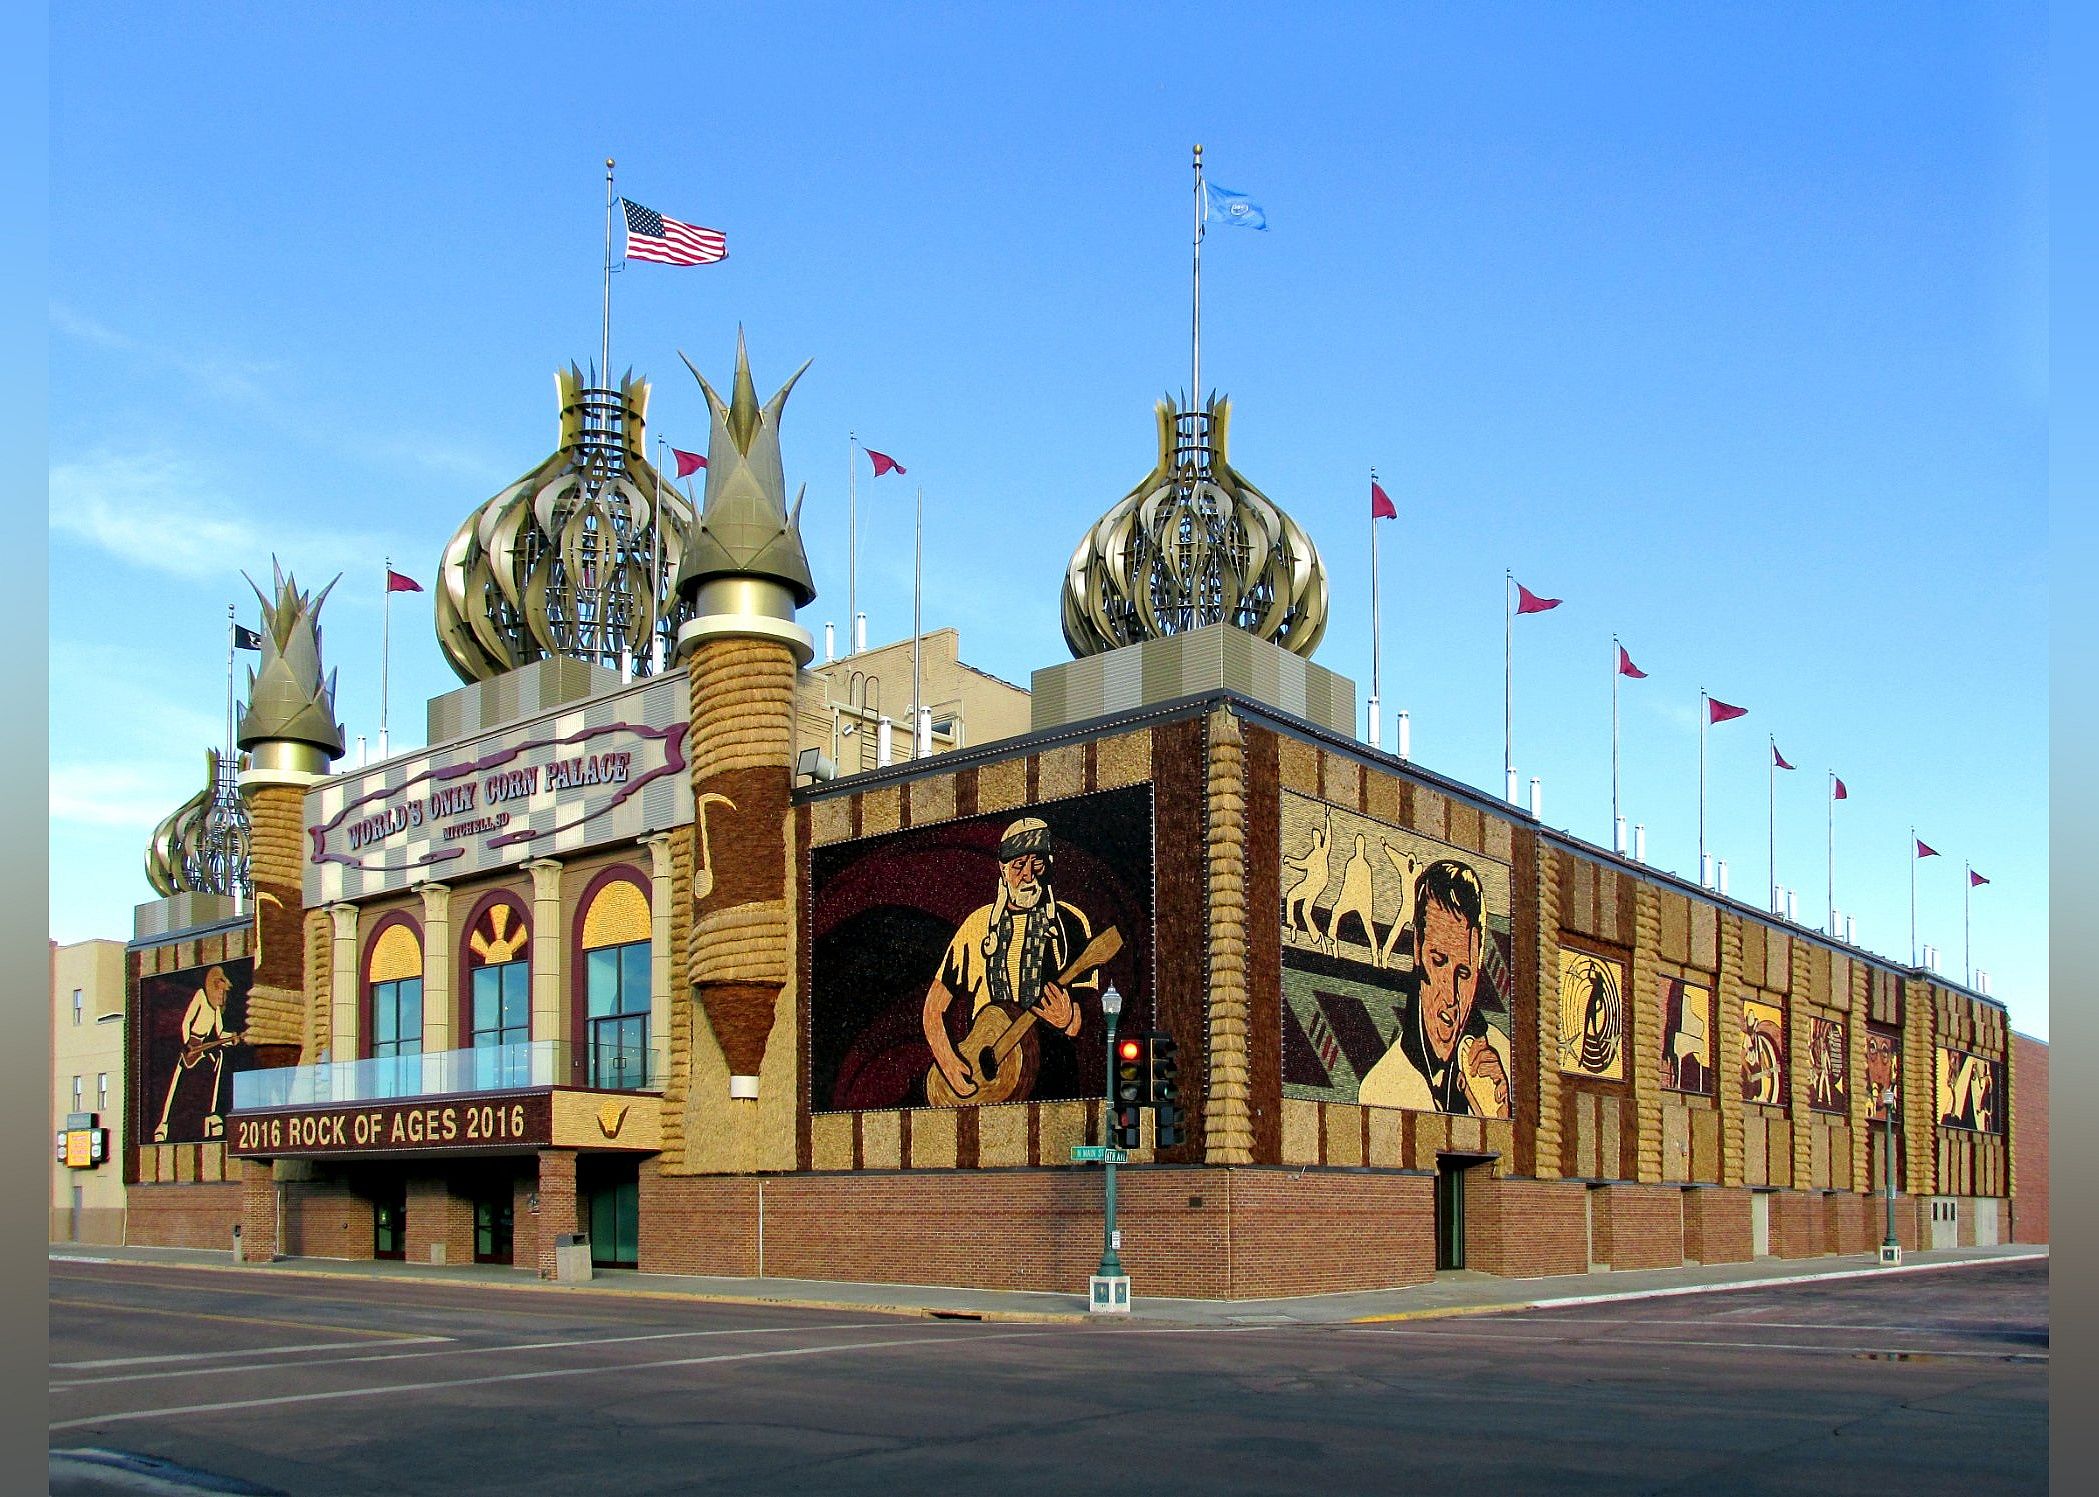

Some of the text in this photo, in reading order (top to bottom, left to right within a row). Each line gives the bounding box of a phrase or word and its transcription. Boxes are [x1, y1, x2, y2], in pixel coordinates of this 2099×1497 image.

[347, 752, 631, 850] WORLD'S ONLY CORN PALACE
[239, 1104, 525, 1149] 2016 ROCK OF AGES 2016
